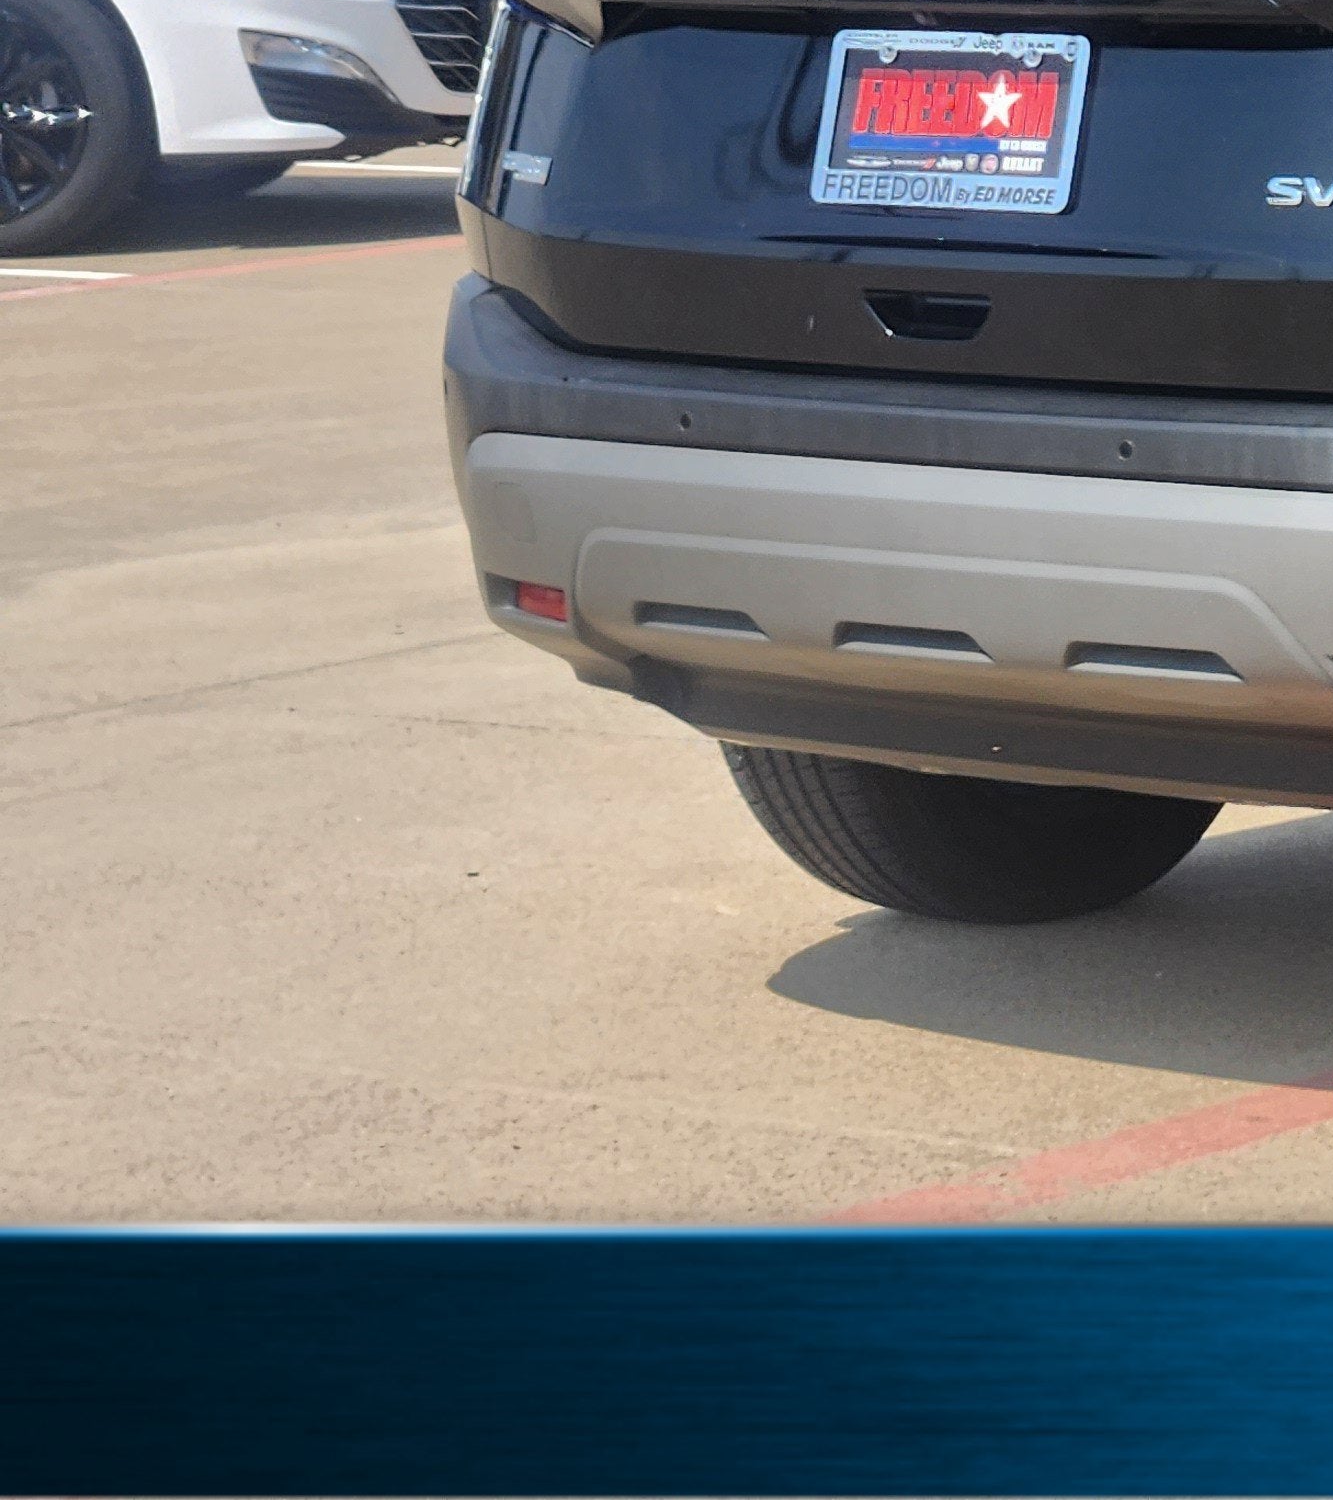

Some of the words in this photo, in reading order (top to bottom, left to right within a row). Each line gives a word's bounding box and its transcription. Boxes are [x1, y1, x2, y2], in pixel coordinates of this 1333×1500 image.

[974, 35, 1004, 52] Jeep
[852, 68, 1060, 140] FREEDOM
[822, 173, 954, 203] FREEDOM
[973, 185, 994, 202] ED
[999, 187, 1058, 206] MORSE
